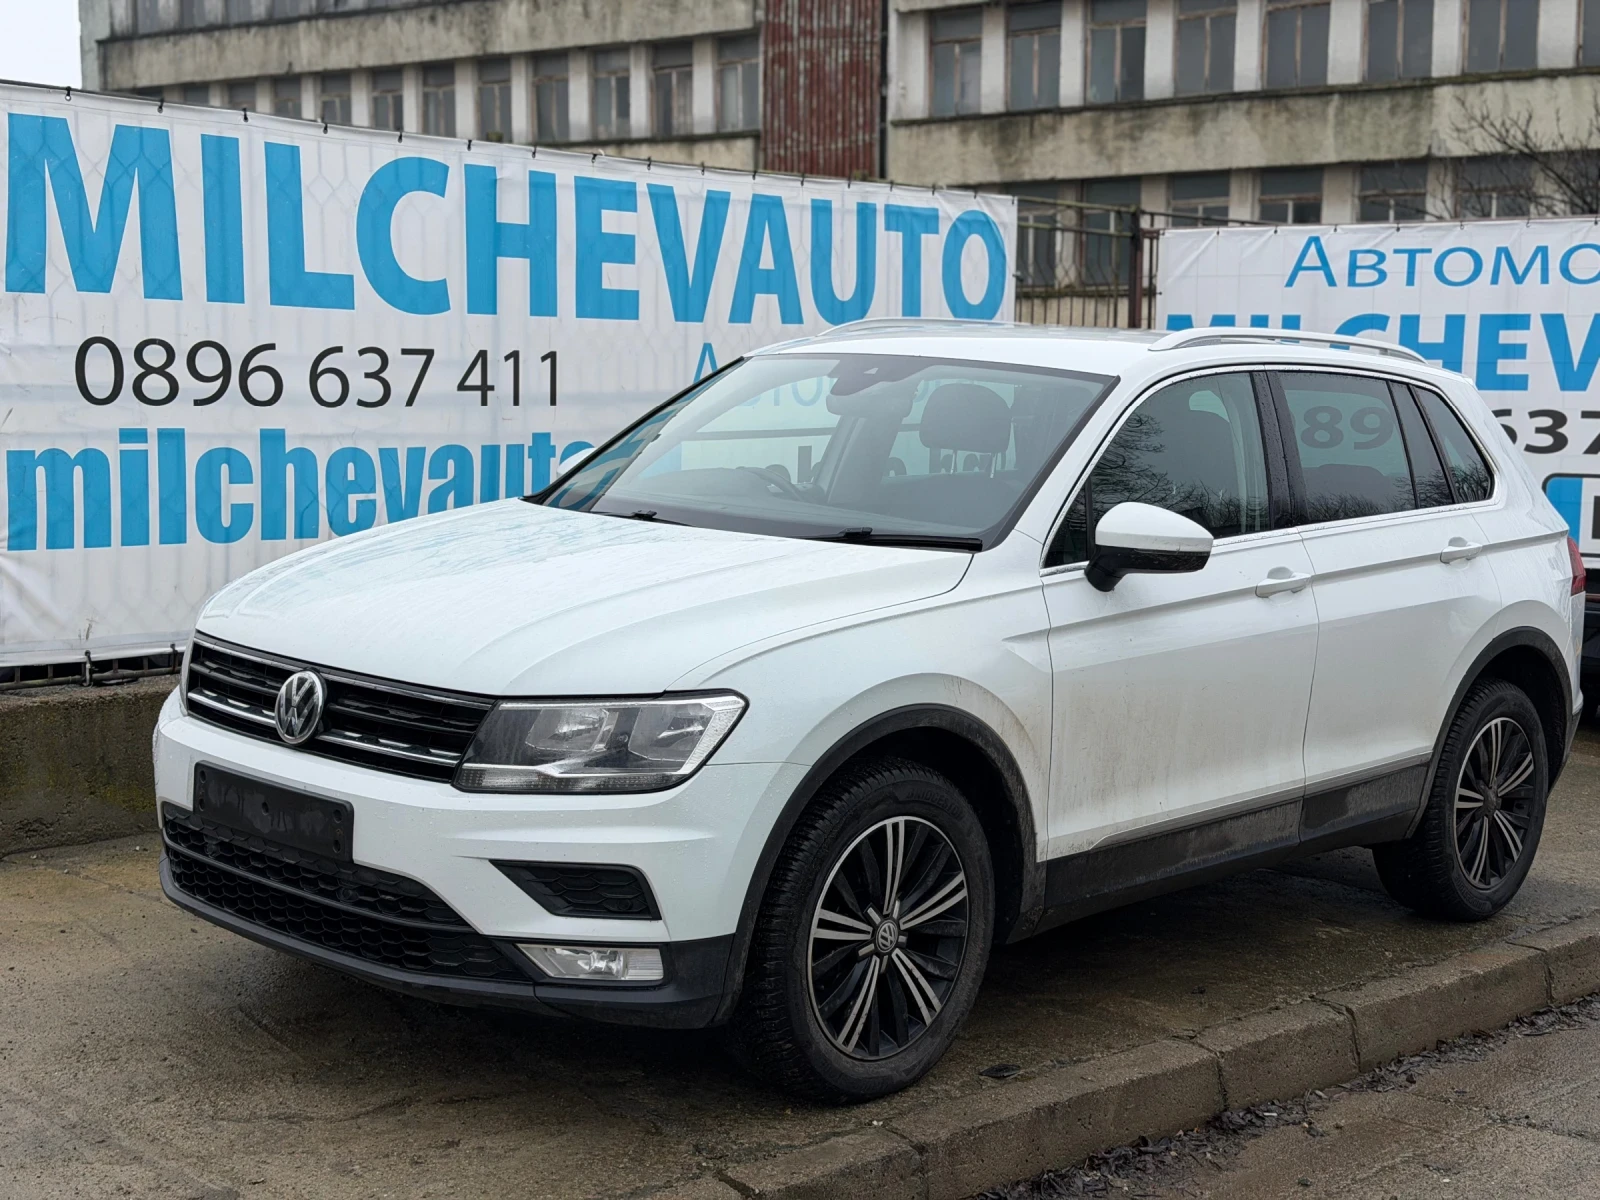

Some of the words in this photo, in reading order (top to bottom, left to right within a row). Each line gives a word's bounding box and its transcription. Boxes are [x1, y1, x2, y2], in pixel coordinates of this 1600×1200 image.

[5, 113, 1007, 325] MILCHEVAUTO
[75, 336, 284, 408] 0896
[308, 346, 435, 408] 637
[456, 349, 557, 406] 411
